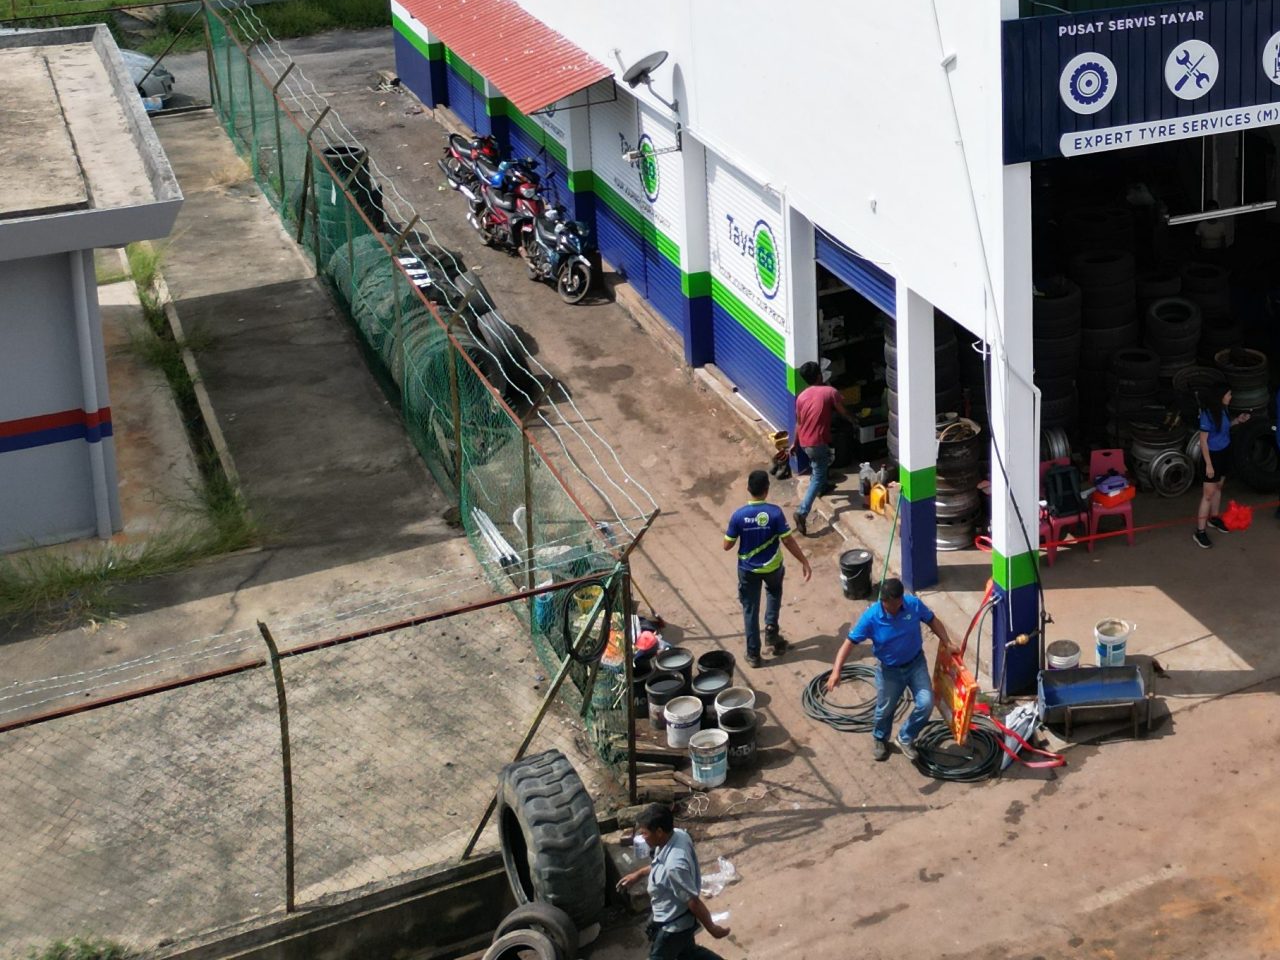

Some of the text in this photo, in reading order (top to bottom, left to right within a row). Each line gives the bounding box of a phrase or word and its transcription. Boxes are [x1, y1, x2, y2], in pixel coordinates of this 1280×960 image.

[1058, 10, 1204, 37] PUSAT SERVIS TAYAR
[1074, 130, 1133, 150] EXPERT
[1139, 124, 1176, 140] TYRE
[1182, 113, 1251, 134] SERVICES
[1256, 108, 1279, 123] (M)
